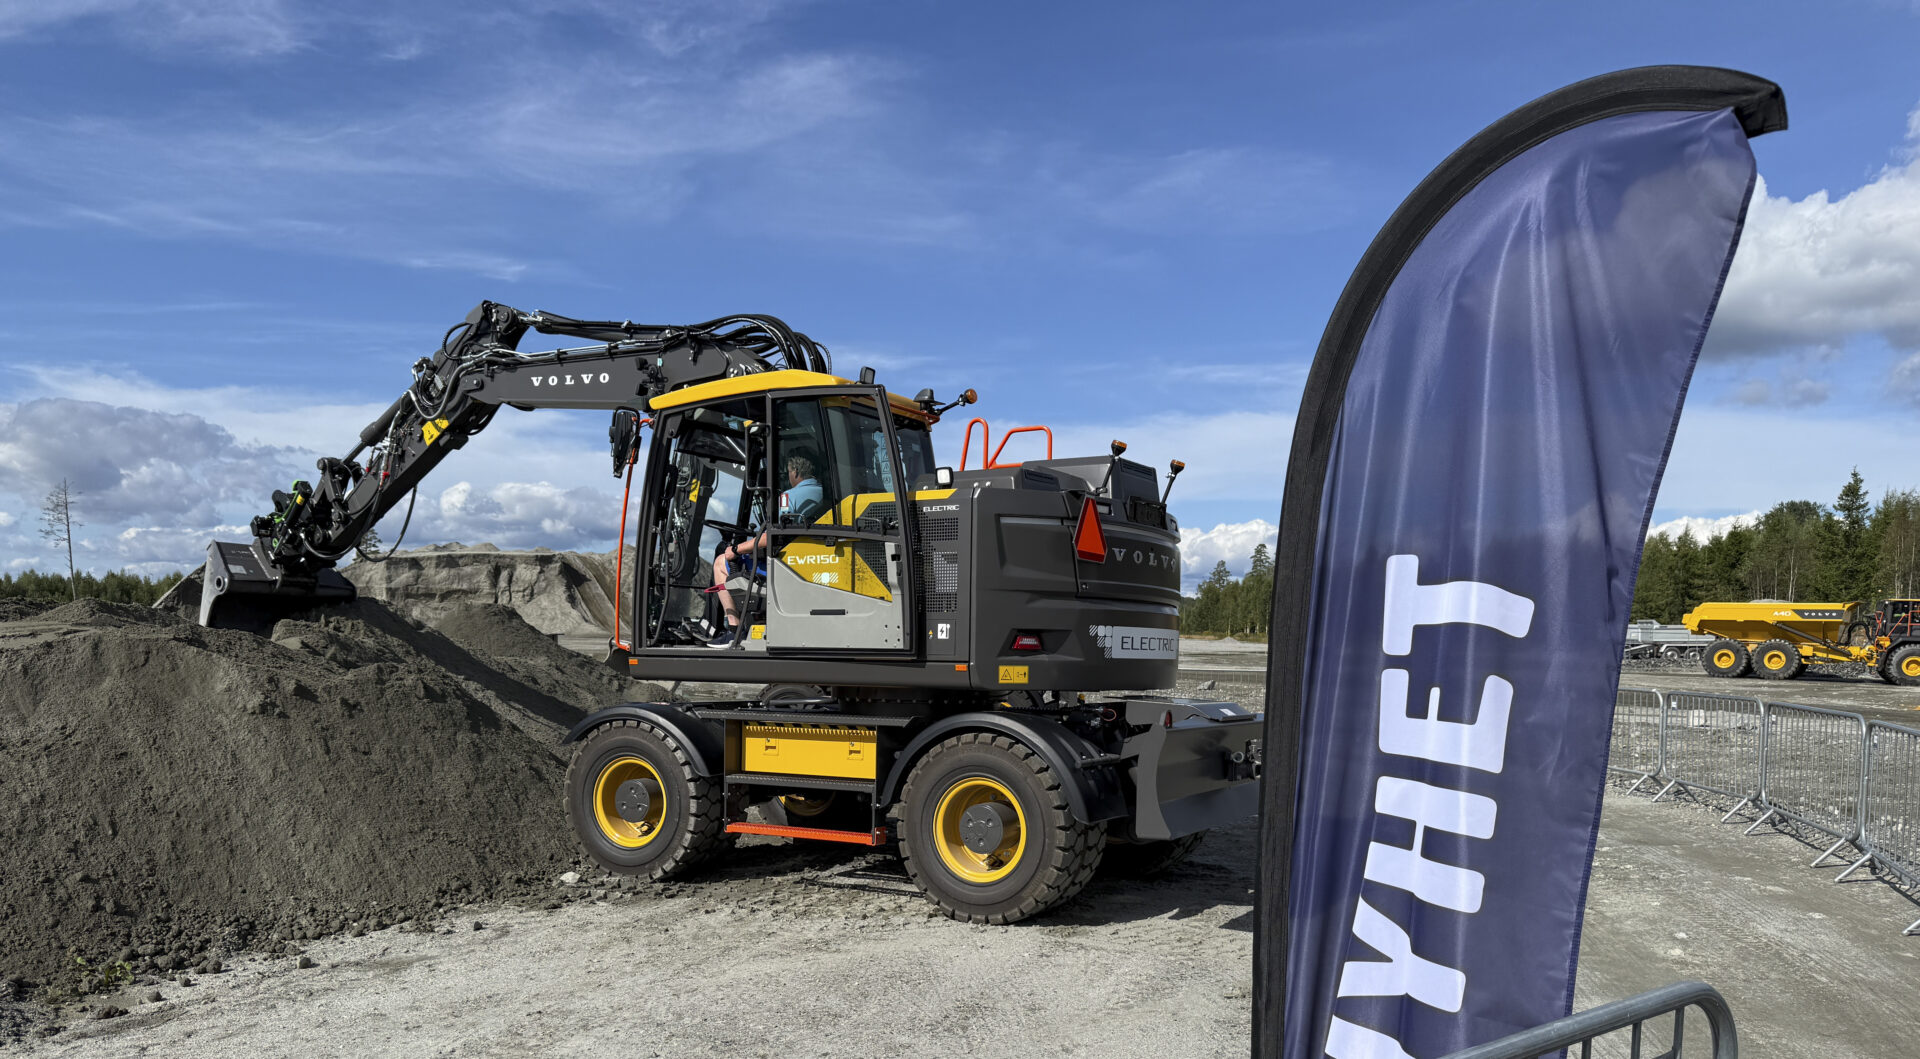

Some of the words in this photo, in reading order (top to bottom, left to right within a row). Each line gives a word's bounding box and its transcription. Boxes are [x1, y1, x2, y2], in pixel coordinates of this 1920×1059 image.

[531, 373, 609, 387] VOLVO
[787, 555, 839, 565] EWR150
[1121, 635, 1175, 652] ELECTRIC
